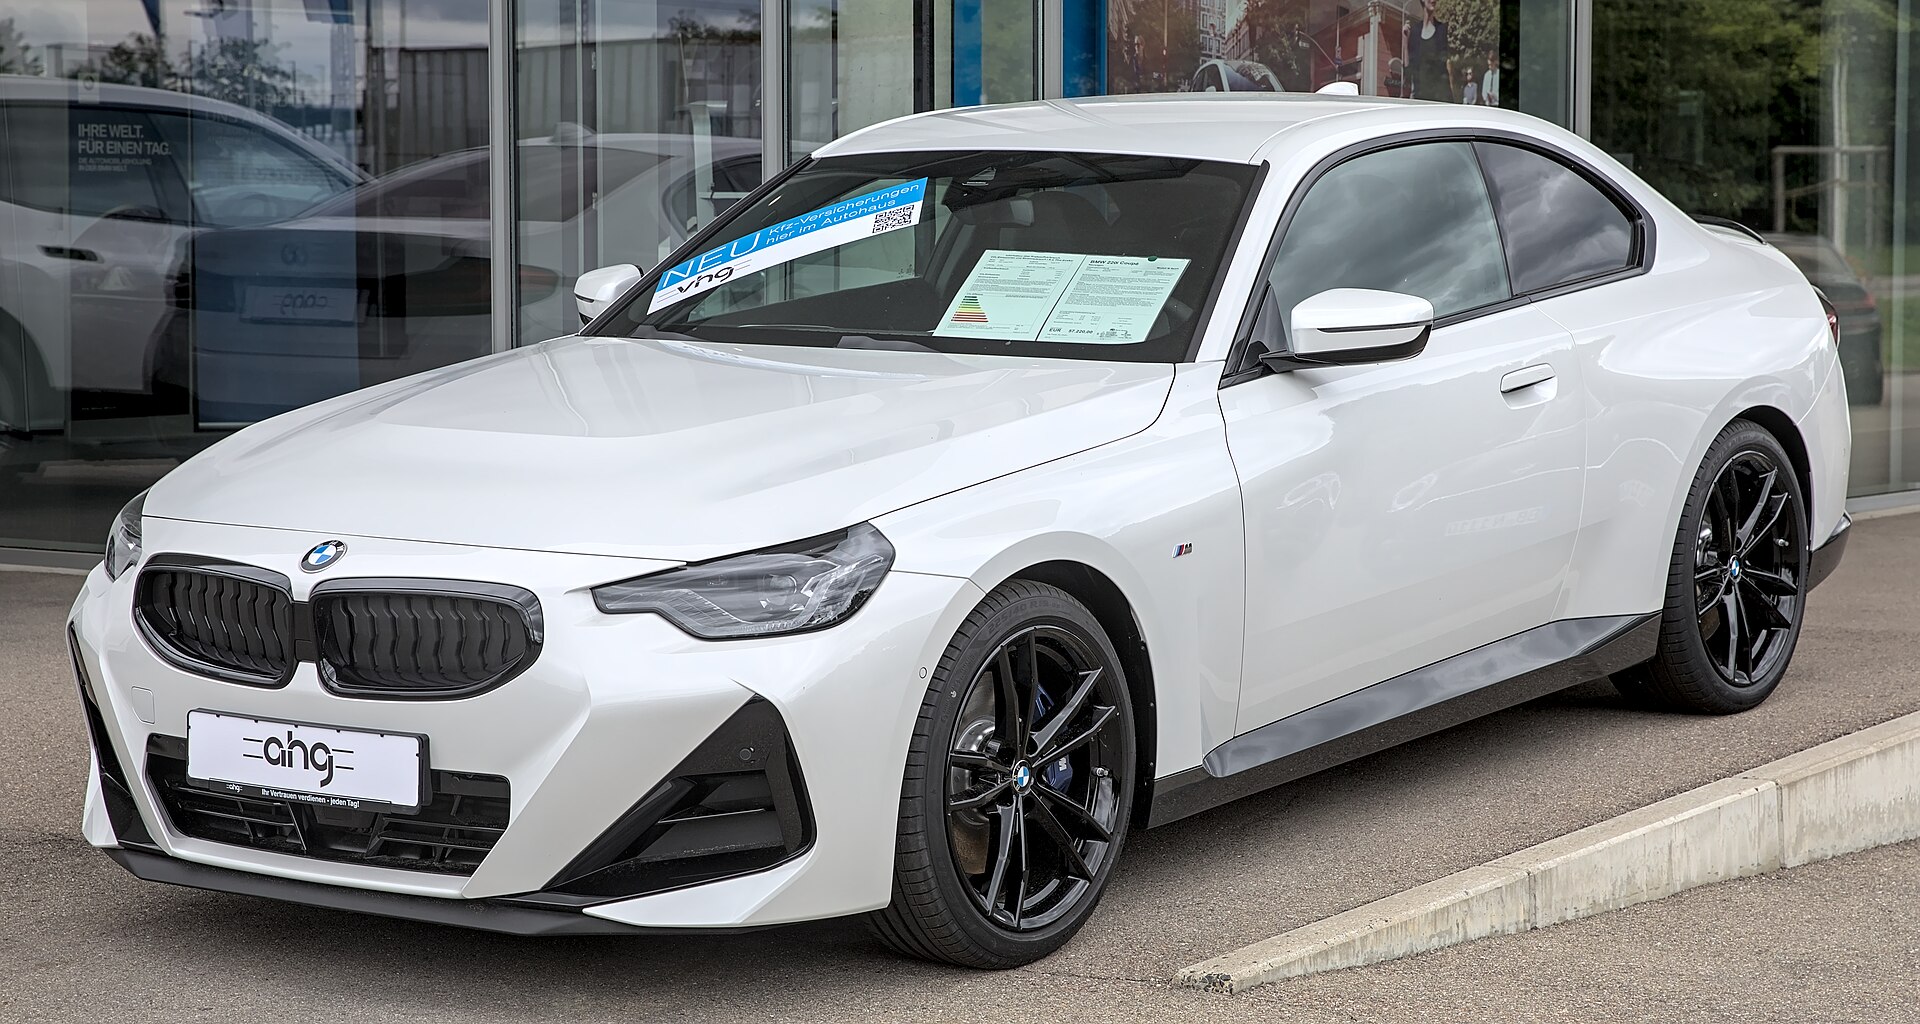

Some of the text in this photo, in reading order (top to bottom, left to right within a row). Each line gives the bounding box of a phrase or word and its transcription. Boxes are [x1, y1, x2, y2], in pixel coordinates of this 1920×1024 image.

[78, 123, 144, 139] IHRE WELT.
[78, 137, 172, 156] FÜR EINEN TAG.
[662, 183, 920, 289] NEU Kfz-Versicherungen
[765, 199, 896, 245] hier im Autohaus
[263, 730, 334, 788] ahg
[261, 788, 270, 796] Ihr
[270, 789, 297, 800] Vertrauen
[298, 793, 326, 804] verdienen
[330, 797, 347, 806] jeden
[347, 799, 360, 809] Tag!
